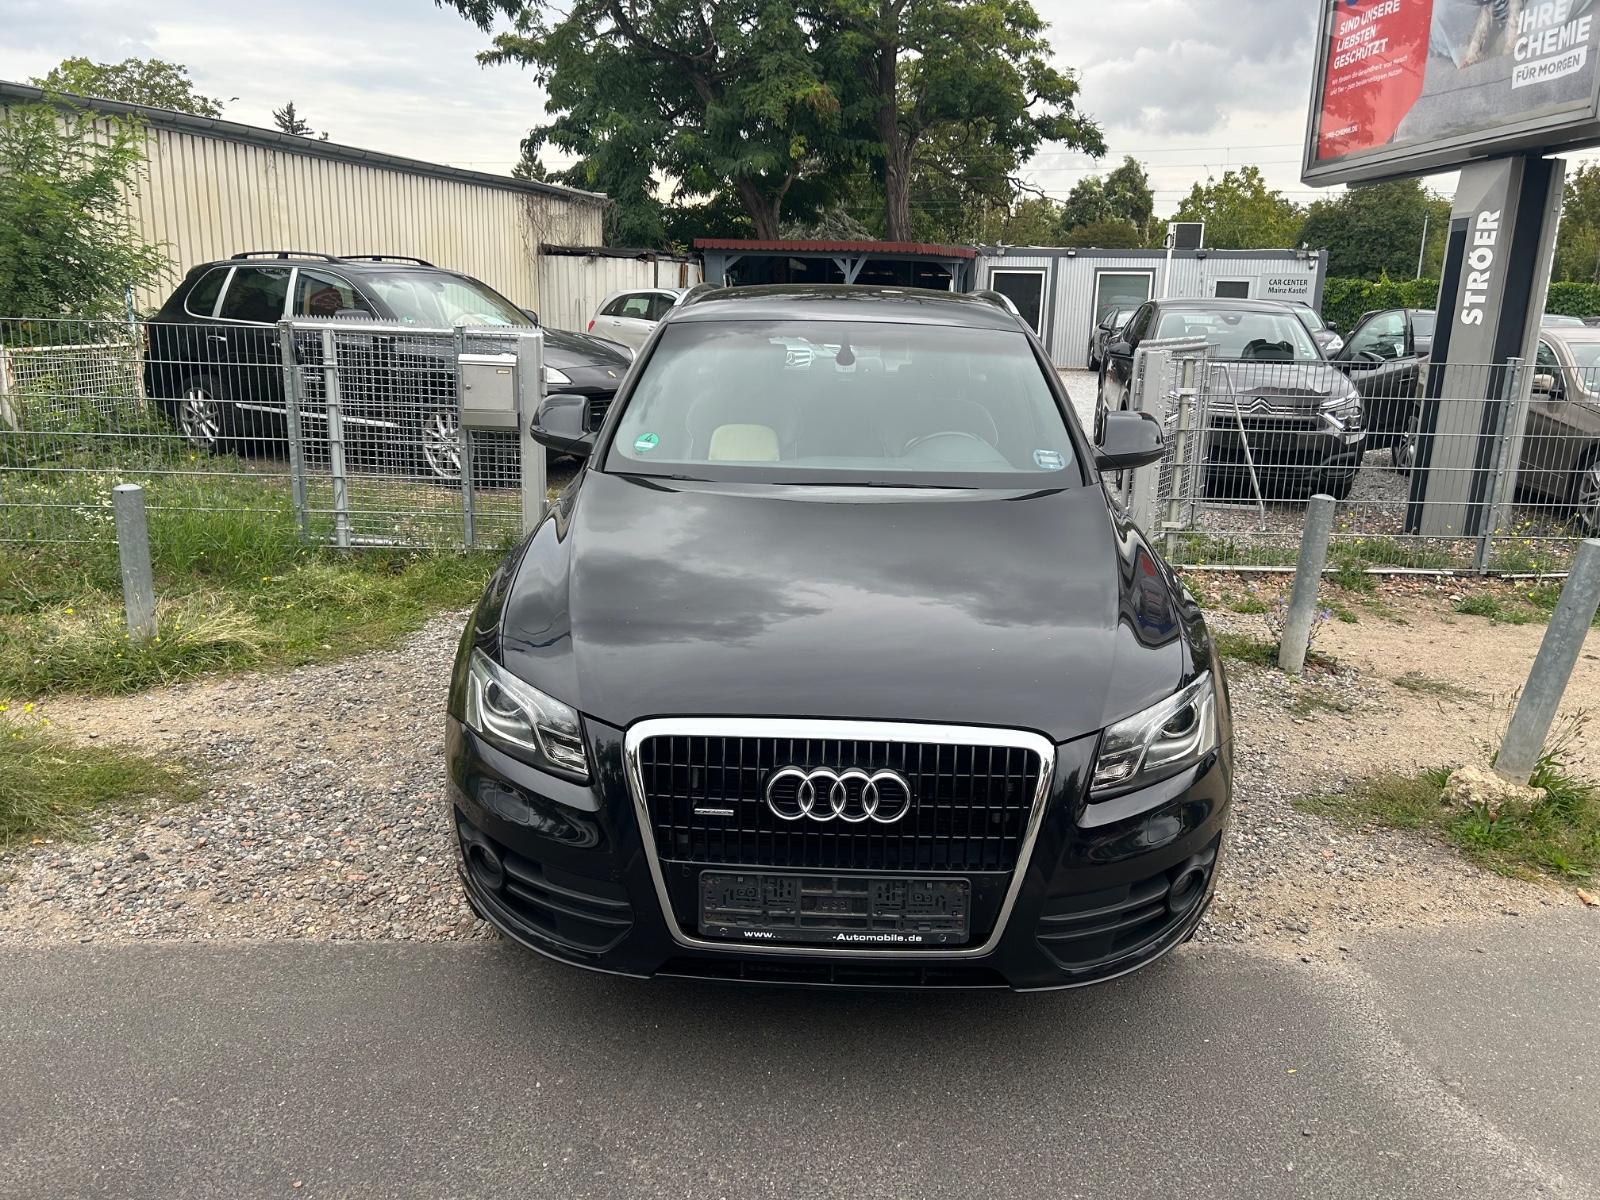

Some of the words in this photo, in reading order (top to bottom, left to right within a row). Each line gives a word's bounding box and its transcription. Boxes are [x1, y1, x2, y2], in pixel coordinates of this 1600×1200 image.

[1339, 16, 1360, 35] SIND
[1361, 0, 1400, 26] UNSERE
[1517, 0, 1569, 35] IHRE
[1333, 37, 1389, 70] GESCHÜTZT
[1336, 24, 1377, 53] LIEBSTEN
[1513, 14, 1592, 61] CHEMIE
[1516, 66, 1537, 83] FÜR
[1538, 53, 1580, 78] MORGEN
[1460, 209, 1501, 326] STRÖER
[743, 930, 776, 939] www.
